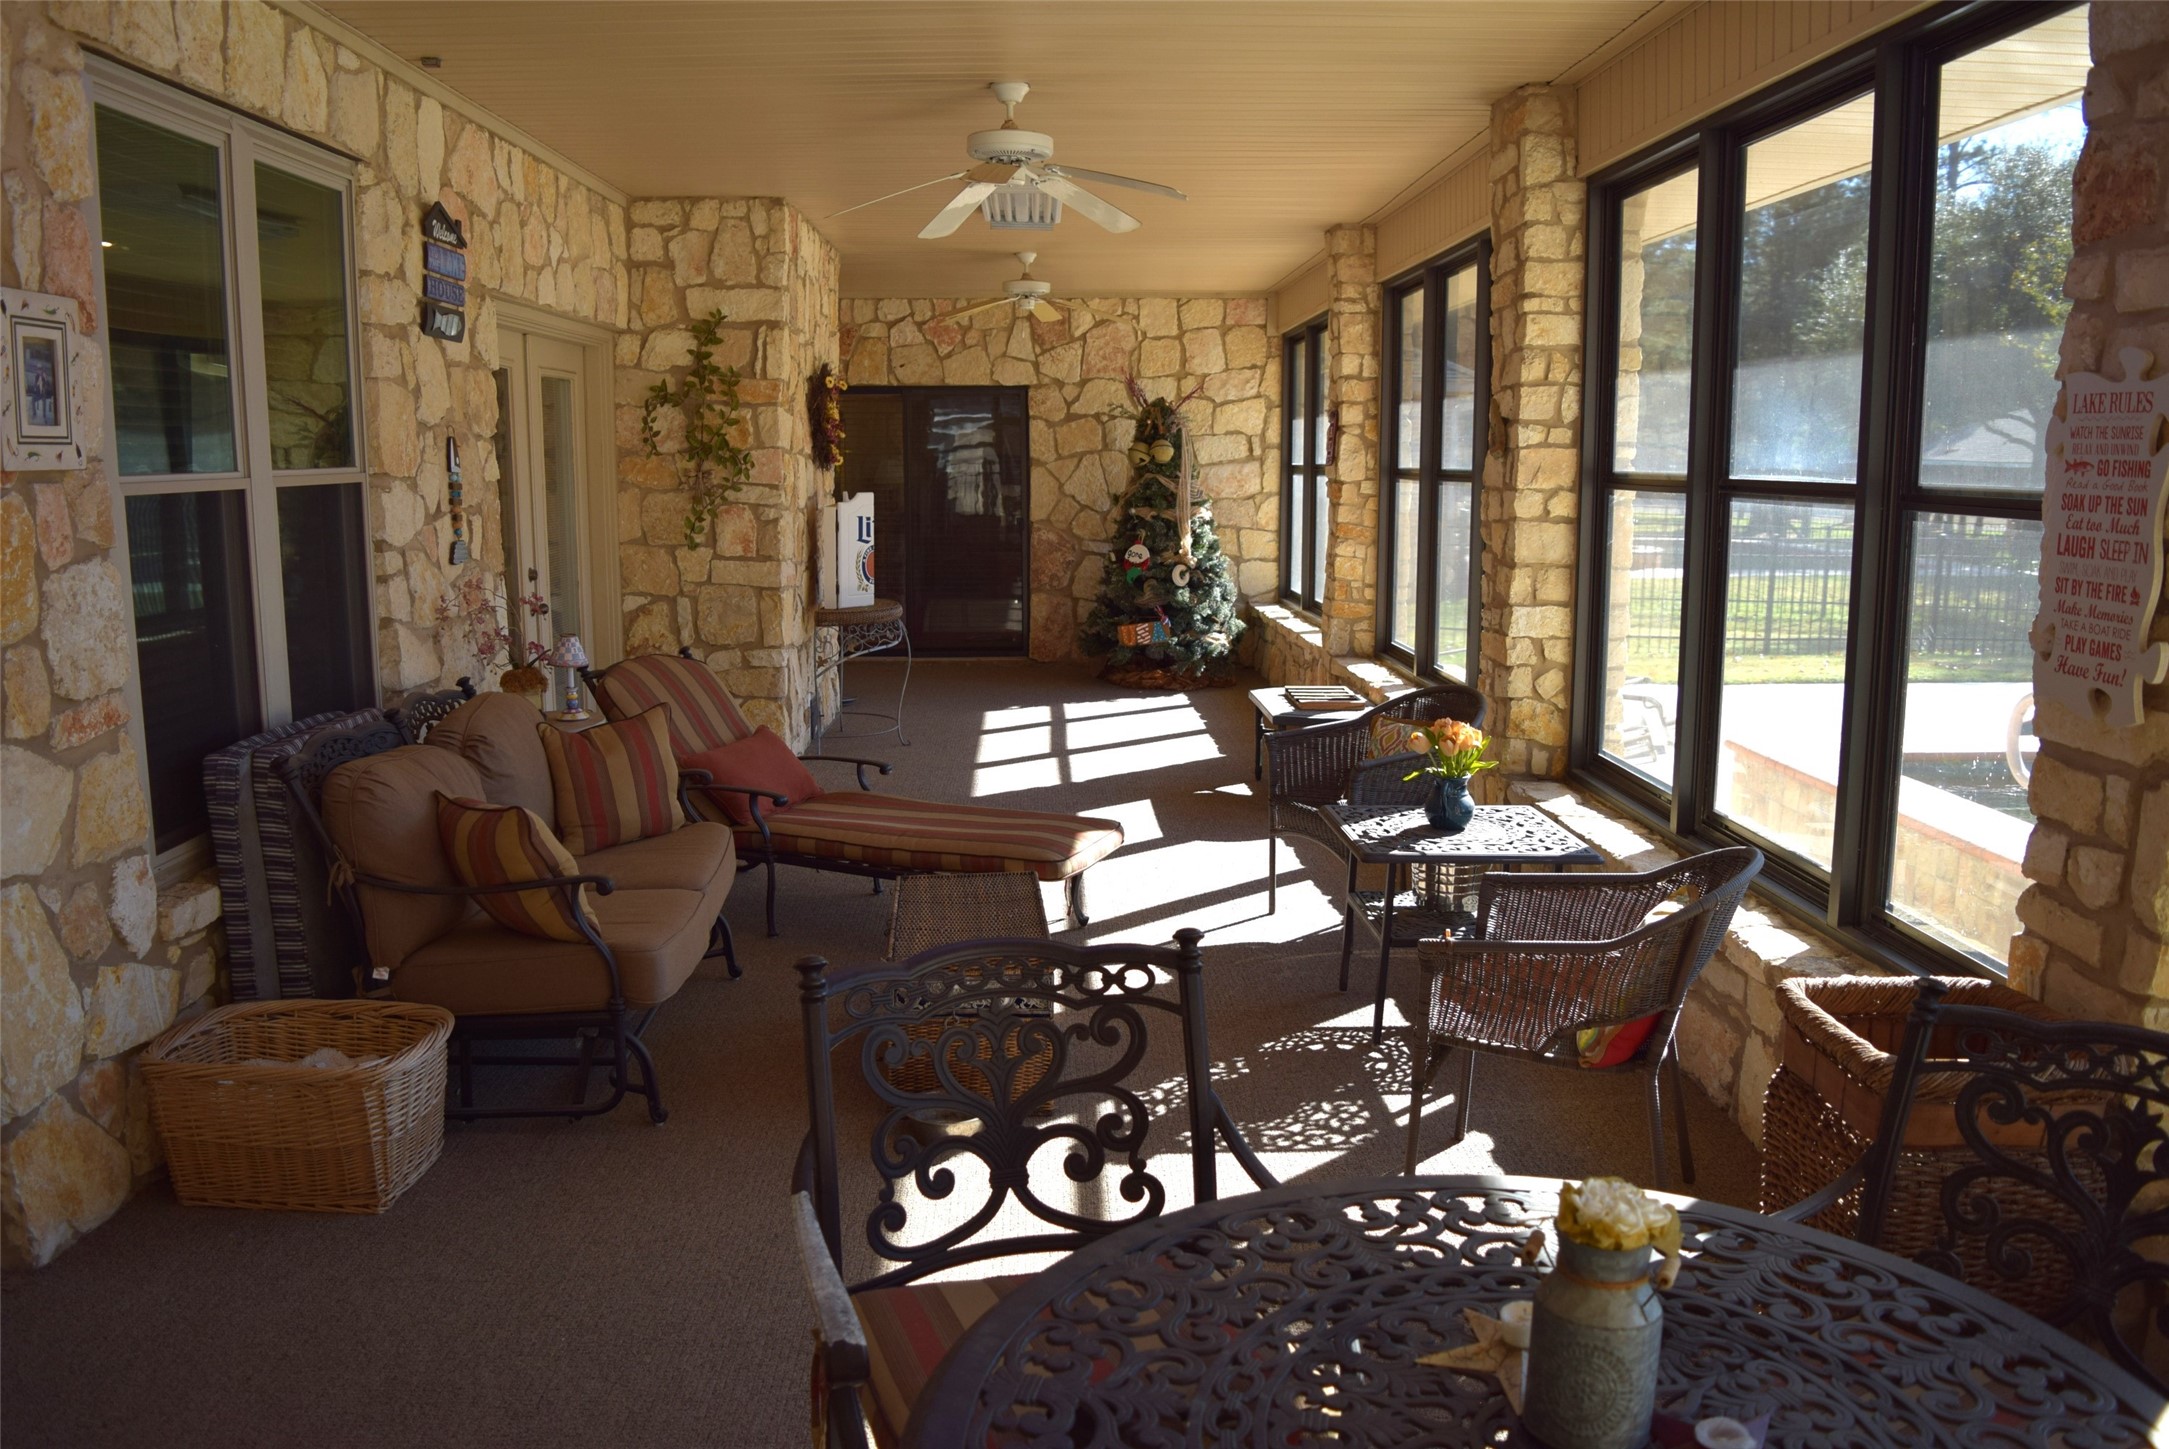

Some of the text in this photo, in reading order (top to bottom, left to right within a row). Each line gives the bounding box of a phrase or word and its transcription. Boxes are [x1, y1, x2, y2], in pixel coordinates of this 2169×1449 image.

[432, 219, 457, 244] Welcome
[429, 280, 463, 303] HOUSE
[2073, 391, 2154, 414] LAKE RULES
[2070, 426, 2144, 440] WATCH THE SUNRISE
[2072, 443, 2139, 456] RELAX AND UNWIND
[2097, 459, 2151, 478] GO FISHING
[2066, 477, 2089, 490] Read
[2102, 479, 2124, 491] Good
[2128, 480, 2148, 493] Book
[2061, 493, 2148, 517] SOAK UP THE SUN
[857, 516, 874, 544] Li
[2066, 513, 2140, 535] Eat too Much
[1127, 550, 1143, 560] gone
[2056, 533, 2149, 564] LAUGH SLEEP IN
[2103, 566, 2118, 580] AND
[2055, 576, 2128, 604] SIT BY THE FIRE
[2053, 599, 2133, 625] Make Memories
[2061, 618, 2131, 641] TAKE A BOAT RIDE
[2065, 634, 2122, 661] PLAY GAMES
[2054, 655, 2127, 687] Have Fun!
